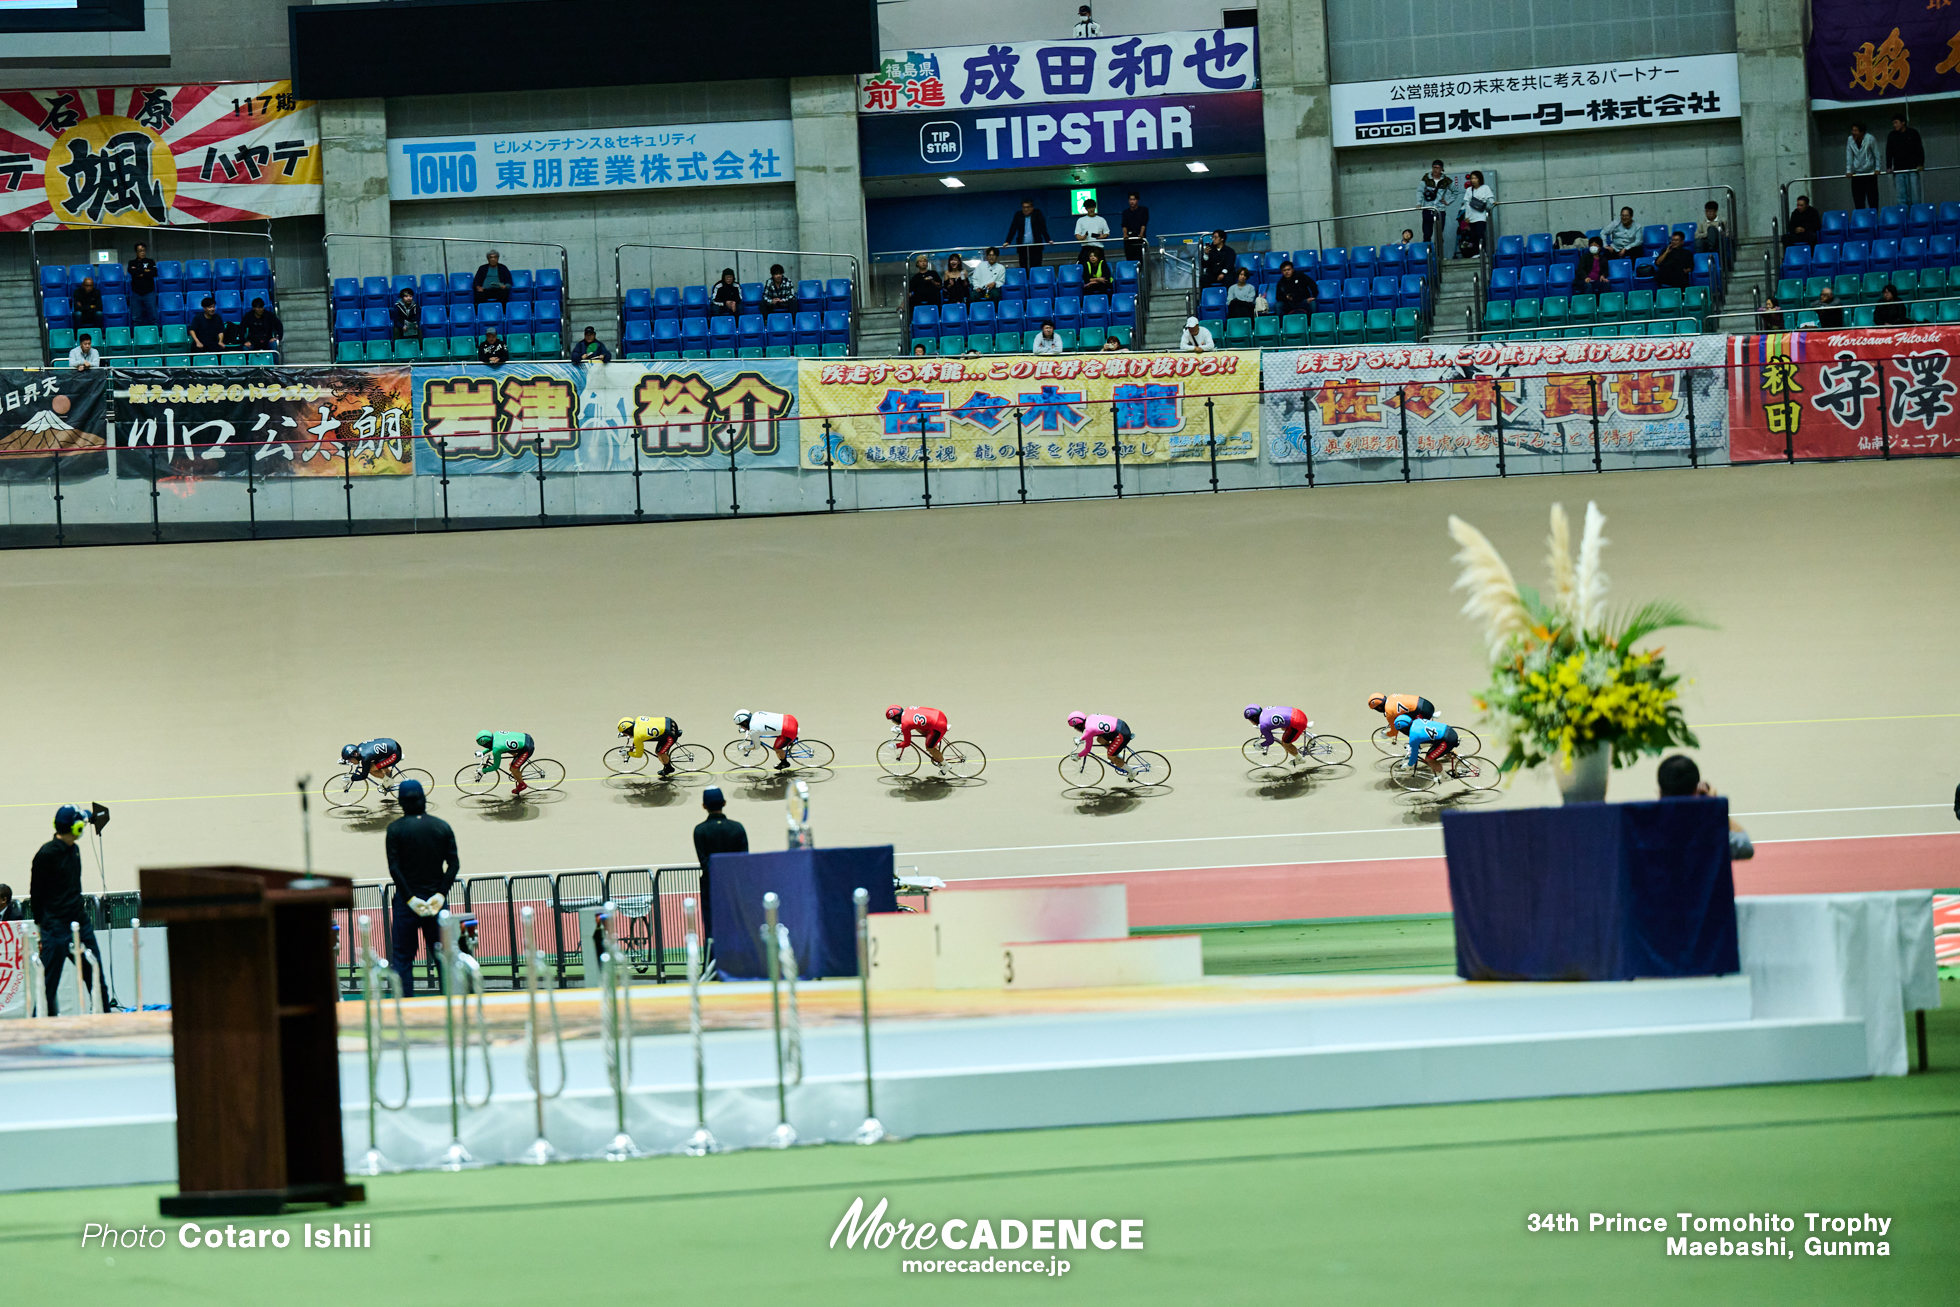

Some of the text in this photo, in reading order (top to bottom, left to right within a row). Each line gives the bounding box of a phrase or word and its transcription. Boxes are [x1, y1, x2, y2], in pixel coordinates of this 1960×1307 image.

[886, 62, 935, 79] 福島県
[960, 29, 1249, 105] 成田和也
[863, 77, 946, 110] 前進
[1390, 67, 1681, 101] 公営競技の未来を共に考えるパートナー
[38, 89, 175, 132] 石原
[231, 91, 297, 117] 117期
[1418, 90, 1721, 136] 日本トーター株式会社
[931, 131, 950, 142] TIP
[975, 106, 1193, 160] TIPSTAR
[1357, 124, 1415, 138] TOTOR
[199, 139, 310, 182] ハヤテ
[926, 142, 957, 154] STAR
[58, 131, 170, 225] 颯
[402, 141, 478, 195] TOHO
[495, 148, 782, 190] 東朋産業株式会社
[1827, 331, 1941, 347] Morisawa Futoshi
[0, 376, 60, 415] 日昇天
[1761, 355, 1803, 434] 秋田
[1811, 350, 1957, 430] 守澤
[128, 405, 404, 465] 川口公太朗
[913, 713, 927, 727] 3
[1271, 713, 1286, 726] 9
[1397, 702, 1410, 714] 7
[647, 726, 660, 739] 5
[1098, 721, 1111, 734] 8
[1425, 726, 1439, 740] 4
[373, 742, 388, 755] 2
[506, 739, 519, 750] 6
[1004, 950, 1015, 984] 3
